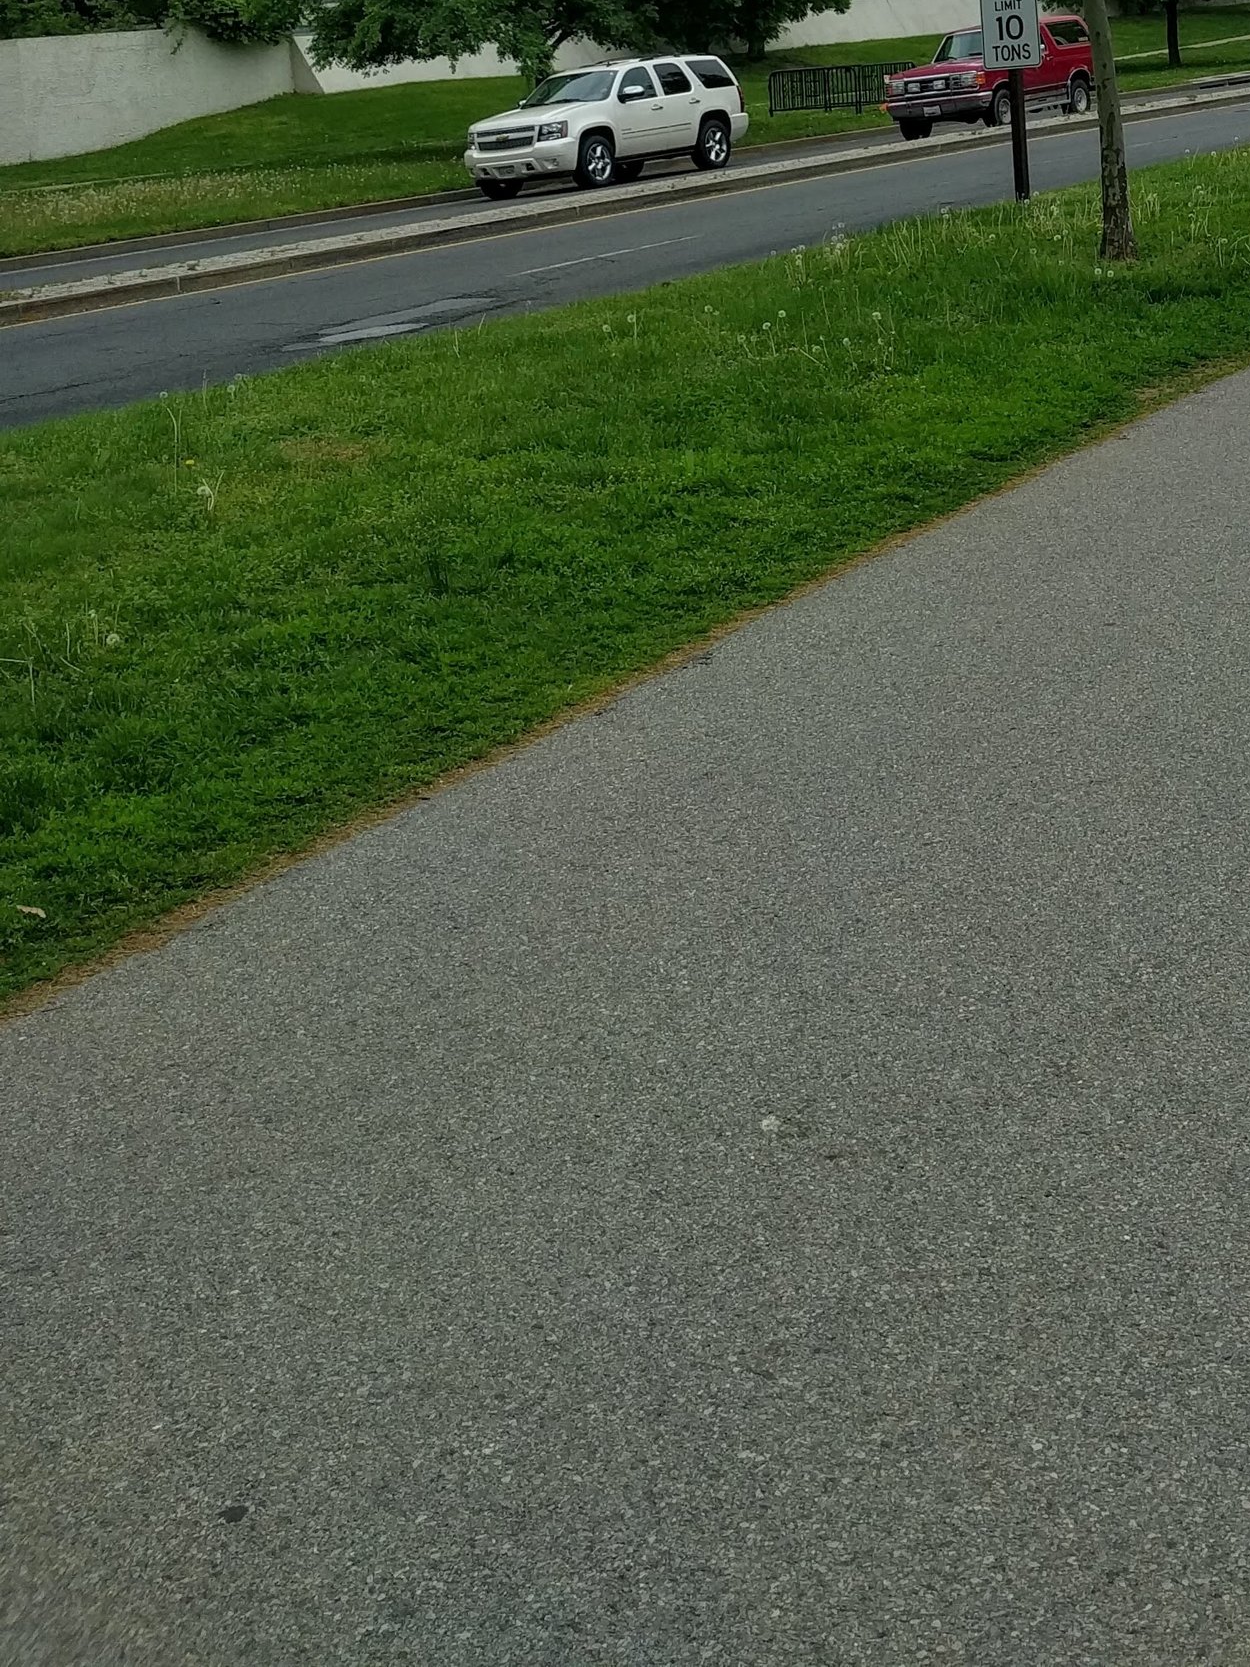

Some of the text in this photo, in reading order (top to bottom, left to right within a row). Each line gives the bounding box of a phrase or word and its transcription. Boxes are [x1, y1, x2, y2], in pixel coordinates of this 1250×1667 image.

[994, 0, 1022, 12] LIMIT
[995, 15, 1024, 41] 10
[992, 43, 1031, 62] TONS
